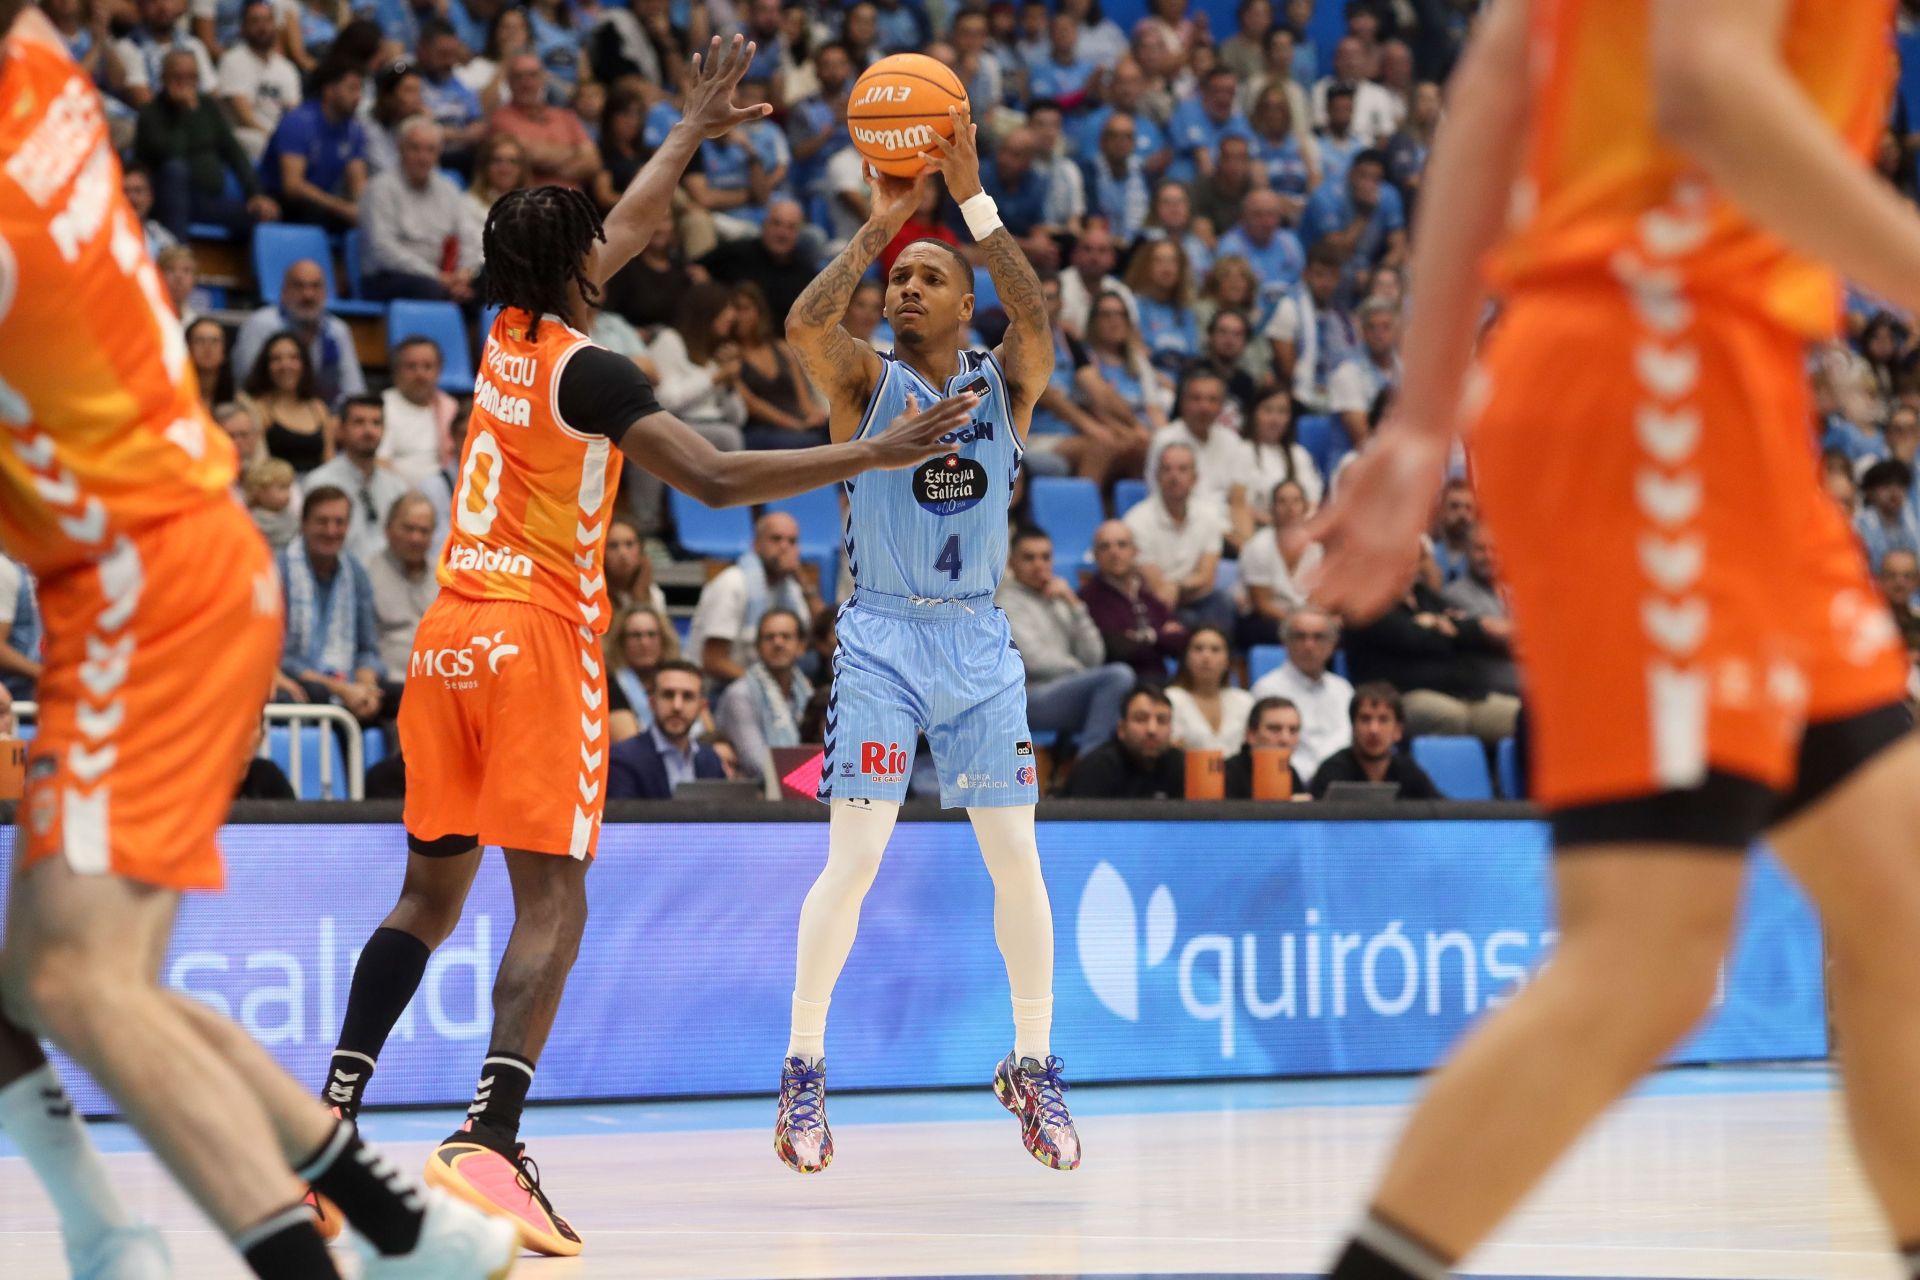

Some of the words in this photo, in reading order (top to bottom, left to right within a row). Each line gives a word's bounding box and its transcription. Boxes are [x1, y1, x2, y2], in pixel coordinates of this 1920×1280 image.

[854, 124, 931, 151] Wilson
[456, 430, 503, 536] 0
[924, 468, 975, 484] Estrella
[933, 533, 963, 581] 4
[411, 648, 475, 678] MGS
[168, 915, 492, 1045] sald
